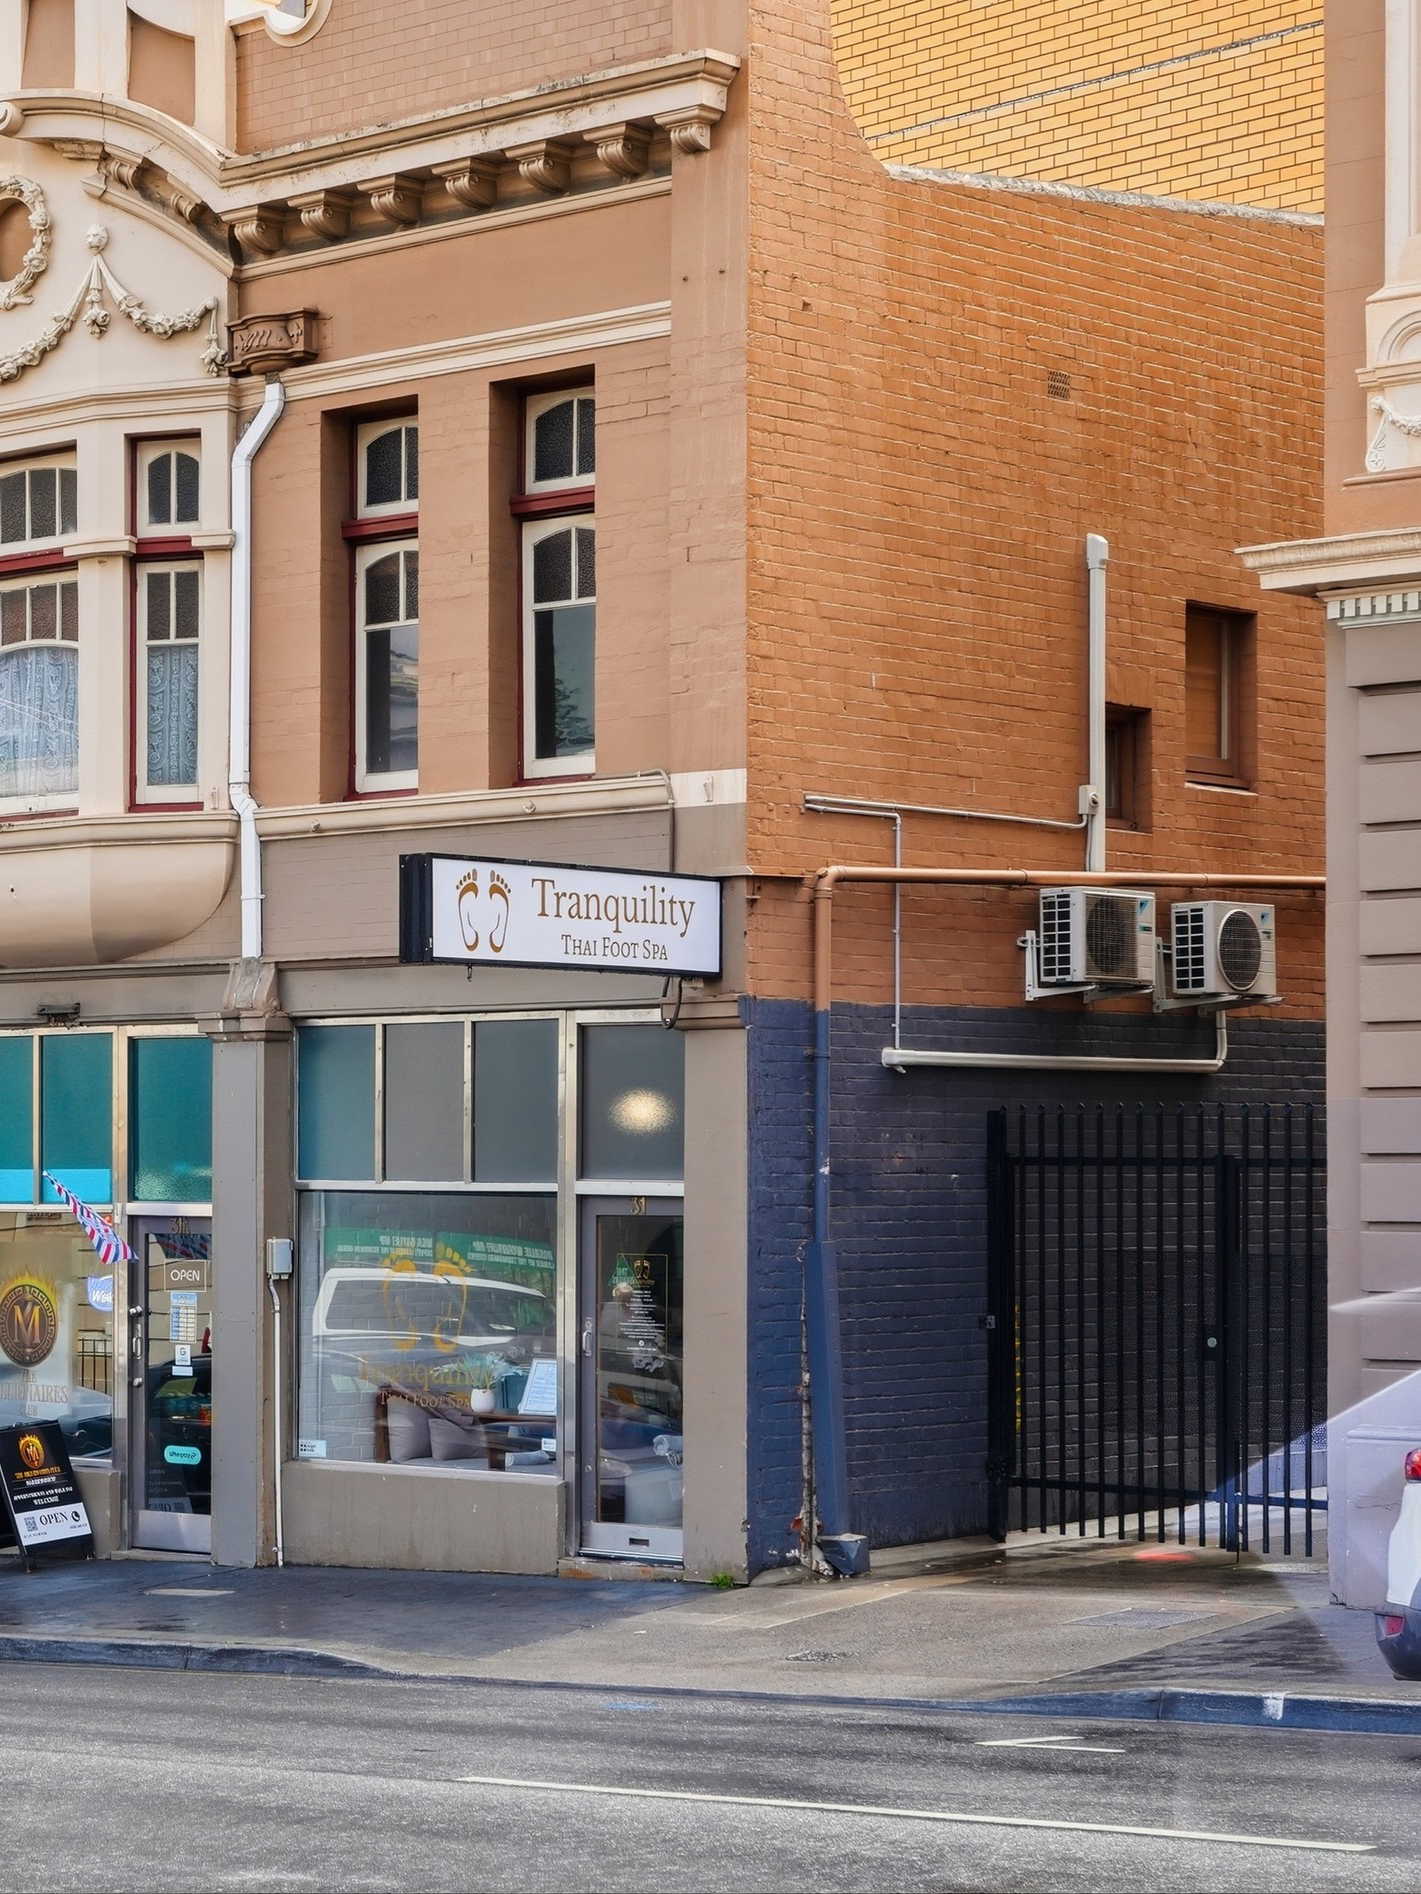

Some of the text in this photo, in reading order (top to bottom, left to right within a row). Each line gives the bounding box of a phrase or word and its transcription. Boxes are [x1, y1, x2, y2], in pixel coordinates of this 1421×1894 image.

[531, 877, 696, 938] Tranquility
[561, 934, 668, 961] THAI FOOT SPA
[170, 1269, 200, 1282] OPEN
[13, 1304, 40, 1346] M
[39, 1511, 69, 1526] OPEN
